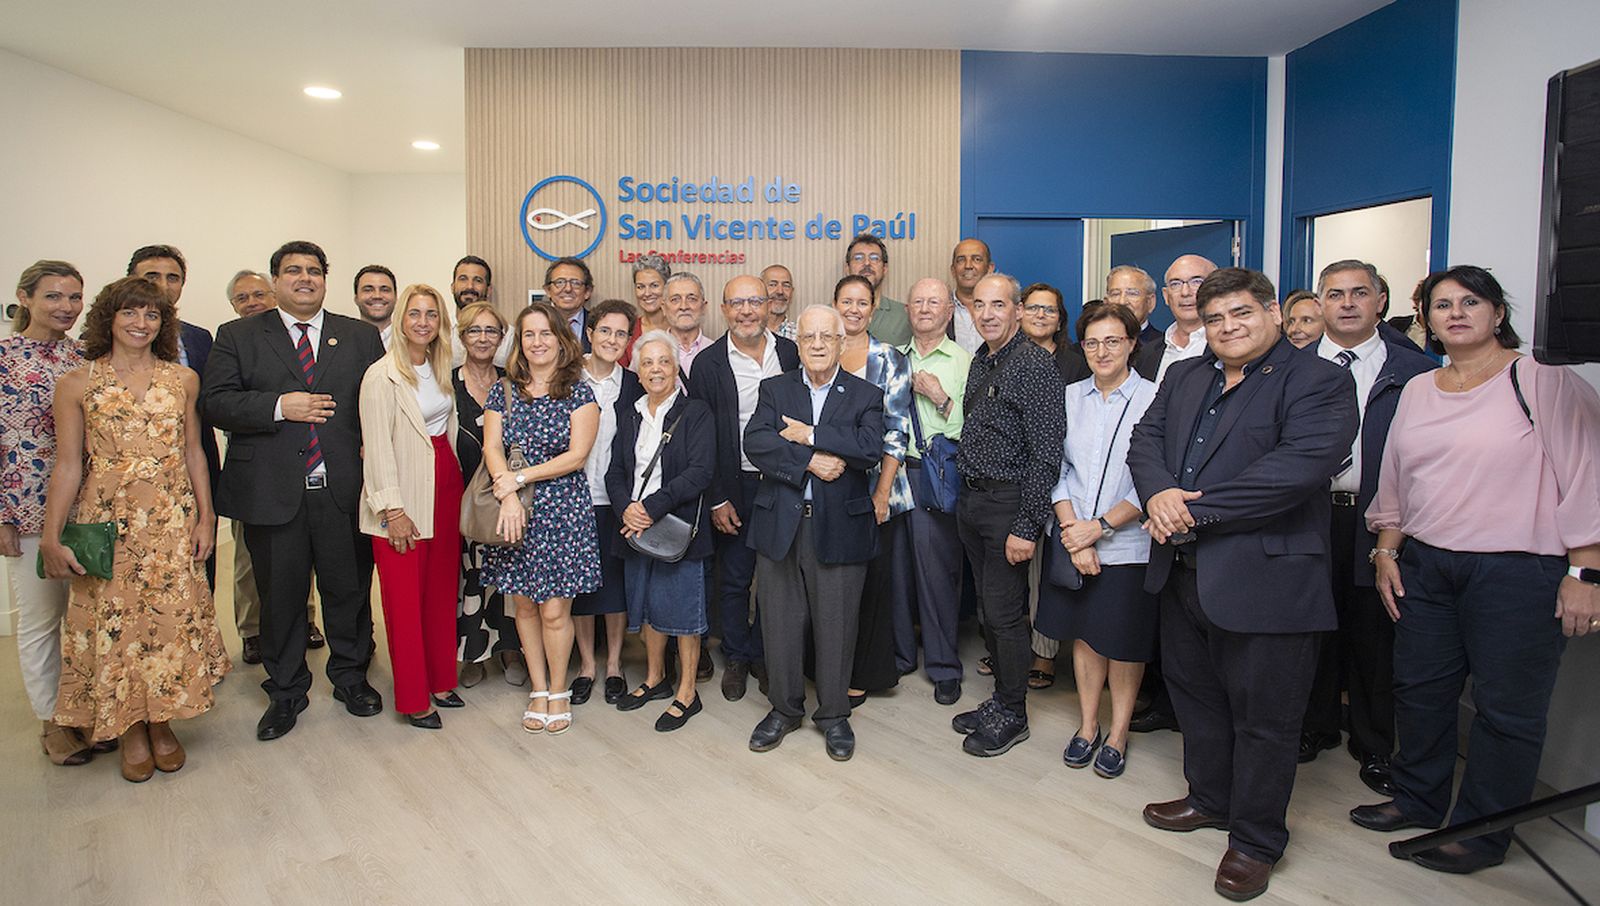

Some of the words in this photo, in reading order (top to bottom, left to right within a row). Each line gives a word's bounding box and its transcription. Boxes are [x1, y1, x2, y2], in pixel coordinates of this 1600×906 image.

[618, 176, 754, 204] Sociedad
[764, 176, 801, 204] de
[618, 213, 673, 241] San
[681, 213, 796, 241] Vicente
[805, 212, 842, 240] de
[853, 211, 916, 241] Paúl
